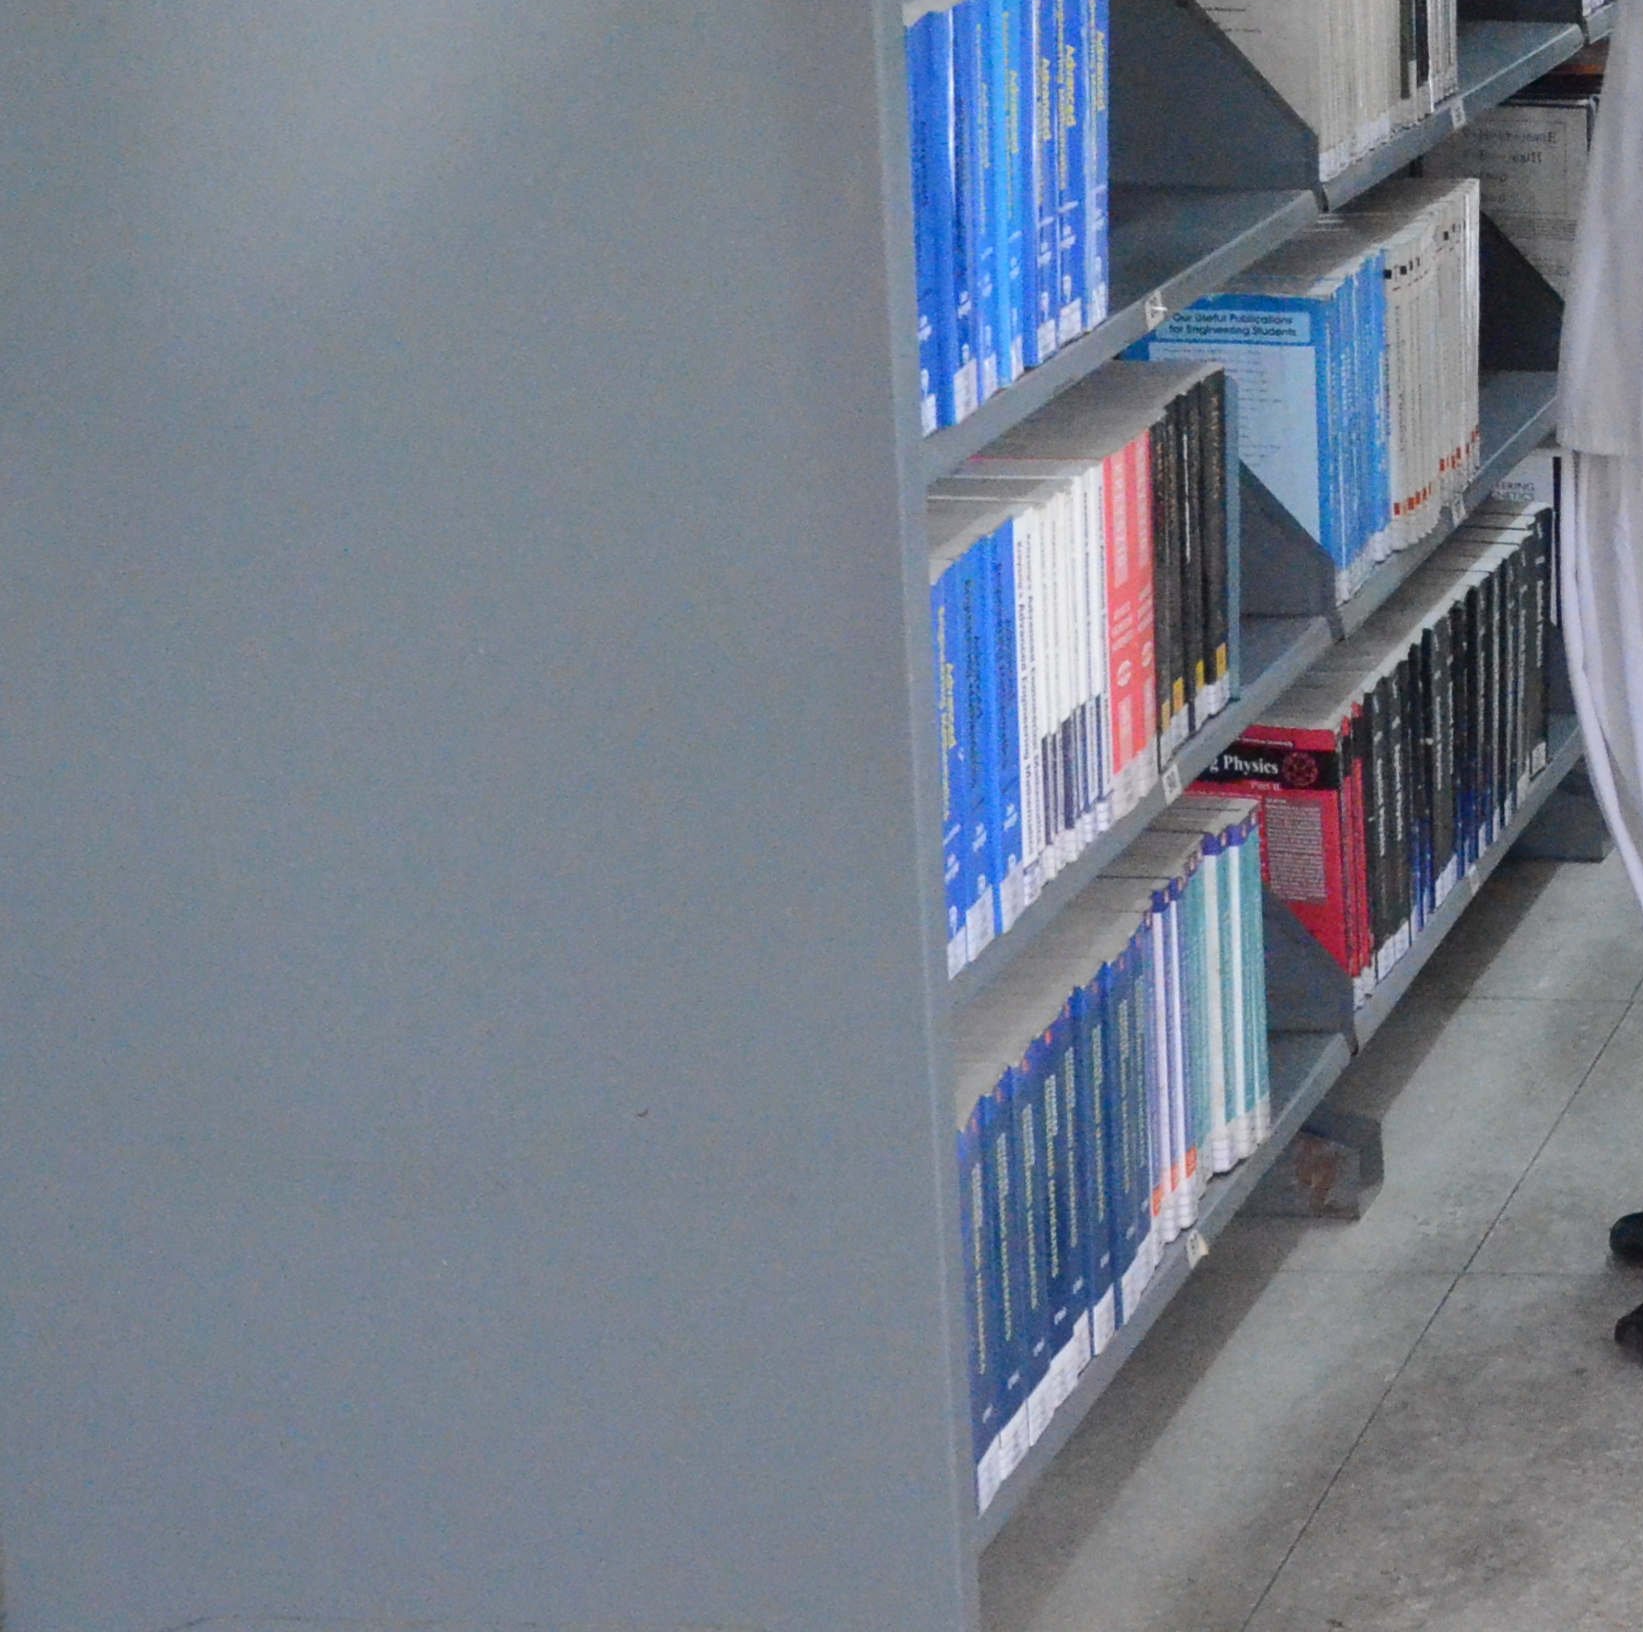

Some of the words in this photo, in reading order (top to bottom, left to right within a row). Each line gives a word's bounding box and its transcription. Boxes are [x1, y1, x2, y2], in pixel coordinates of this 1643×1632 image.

[1064, 45, 1077, 127] Advanced
[1096, 31, 1106, 111] Advanced
[1040, 58, 1052, 141] Advanced
[1169, 324, 1182, 332] for
[1187, 324, 1249, 336] Engineering
[1253, 324, 1296, 337] Students
[1173, 312, 1194, 322] Our
[1196, 312, 1226, 323] Useful
[1229, 312, 1292, 324] Publications
[1223, 755, 1279, 776] Physics
